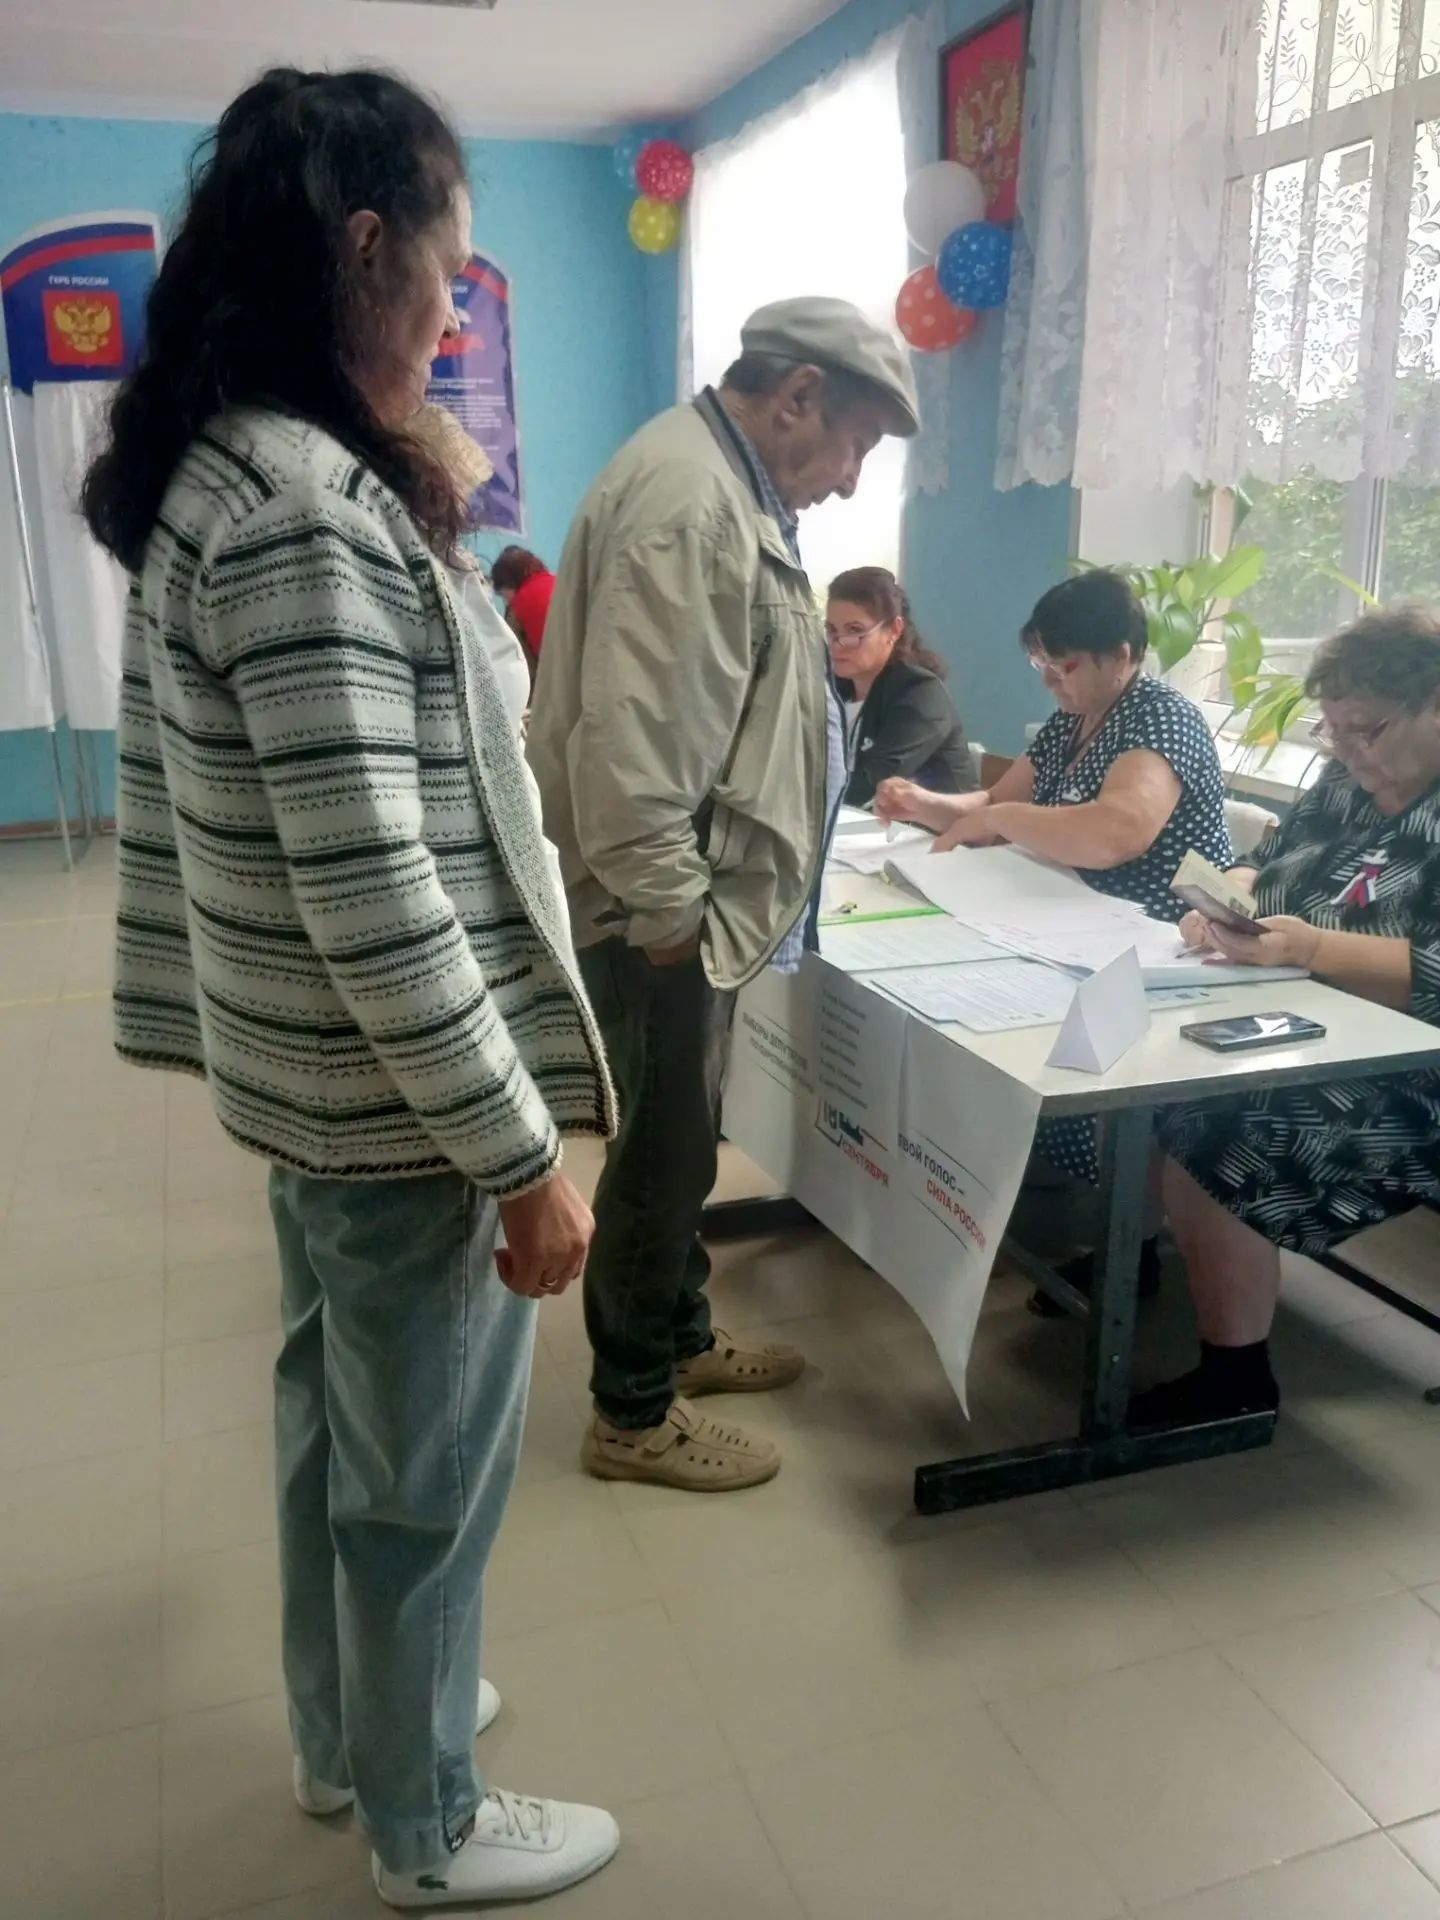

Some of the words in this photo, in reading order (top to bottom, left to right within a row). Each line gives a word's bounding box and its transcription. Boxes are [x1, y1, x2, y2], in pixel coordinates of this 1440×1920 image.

[898, 1132, 922, 1164] ТВОЙ
[924, 1154, 957, 1191] ГОЛОС
[926, 1178, 952, 1213] СИЛА
